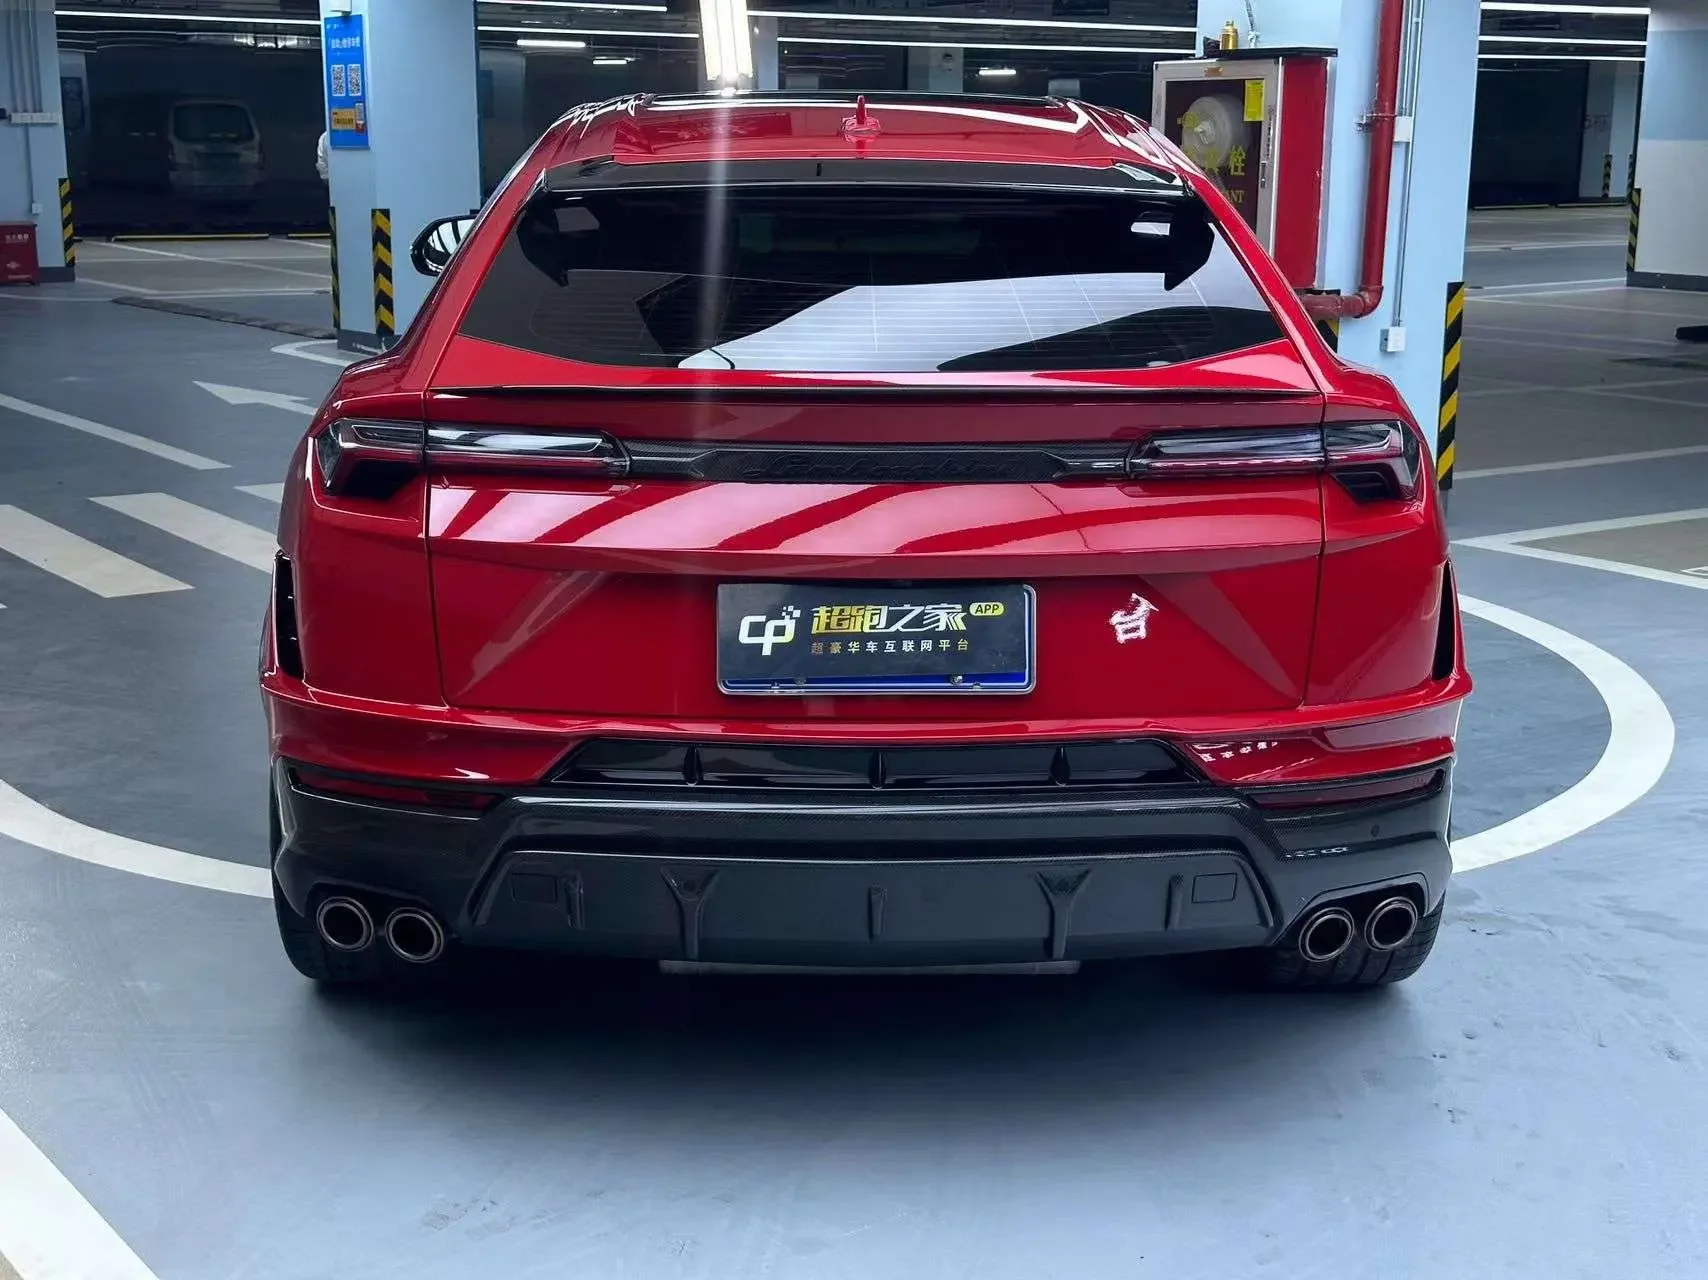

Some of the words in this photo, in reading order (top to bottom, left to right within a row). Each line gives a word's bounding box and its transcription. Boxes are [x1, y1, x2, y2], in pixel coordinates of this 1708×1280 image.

[811, 604, 967, 635] 超跑之家
[974, 603, 1001, 615] APP
[811, 638, 969, 655] 超豪华车互联网平台
